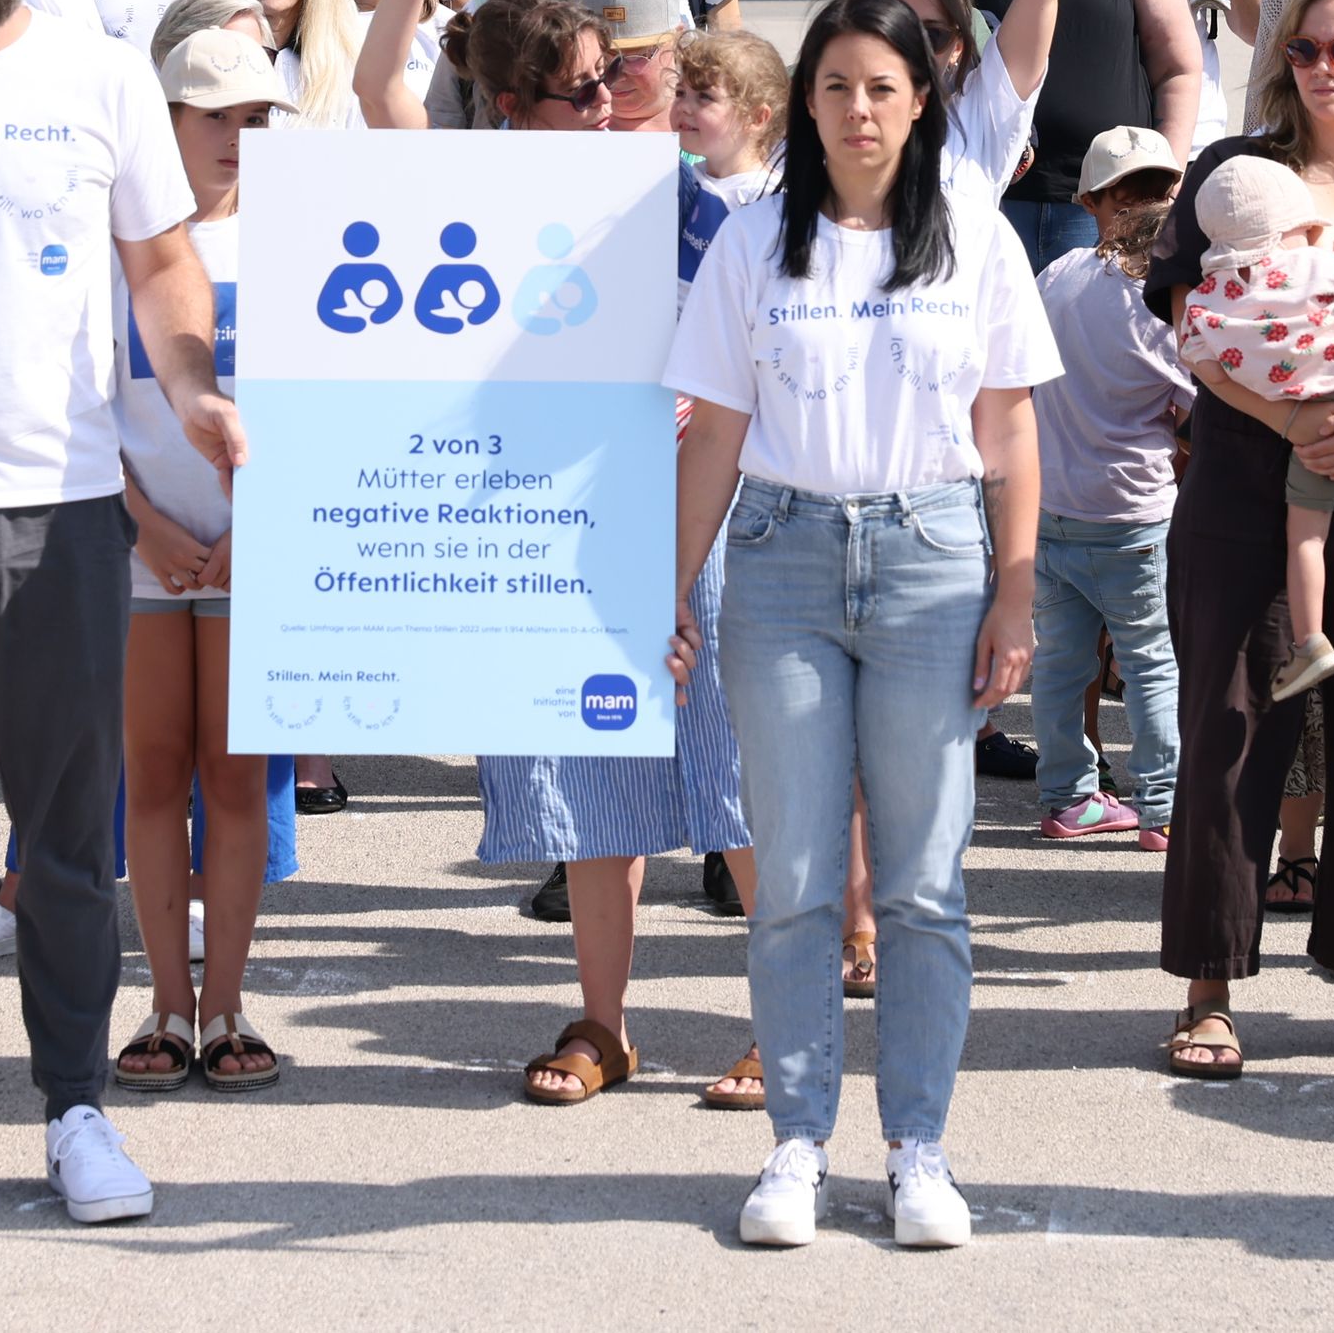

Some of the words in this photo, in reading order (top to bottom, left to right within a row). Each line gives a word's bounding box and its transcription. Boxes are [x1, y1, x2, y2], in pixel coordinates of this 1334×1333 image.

[5, 124, 77, 142] Recht.
[21, 209, 43, 219] wo
[48, 196, 69, 215] ich
[67, 165, 78, 192] will.
[769, 304, 843, 325] Stillen.
[851, 297, 904, 318] Mein
[890, 337, 903, 362] Ich
[897, 365, 921, 391] still,
[778, 372, 799, 398] still,
[805, 389, 826, 400] wo
[408, 434, 424, 454] 2
[432, 438, 480, 454] von
[487, 434, 502, 455] 3
[357, 468, 446, 489] Mütter
[455, 469, 552, 490] erleben
[312, 502, 429, 528] negative
[437, 503, 595, 529] Reaktionen,
[357, 541, 425, 558] wenn
[434, 536, 468, 558] sie
[477, 537, 499, 558] in
[508, 538, 551, 559] der
[314, 566, 498, 593] Öffentlichkeit
[506, 572, 593, 594] stillen.
[310, 624, 344, 634] Umfrage
[363, 624, 385, 632] MAM
[405, 624, 432, 633] Thema
[459, 625, 480, 633] 2022
[526, 625, 558, 634] Müttern
[570, 626, 603, 634] D-A-CH
[267, 670, 314, 682] Stillen.
[318, 670, 353, 682] Mein
[356, 670, 400, 683] Recht.
[533, 697, 576, 706] Initiative
[555, 687, 576, 695] eine
[586, 695, 634, 709] mam
[558, 710, 576, 718] von
